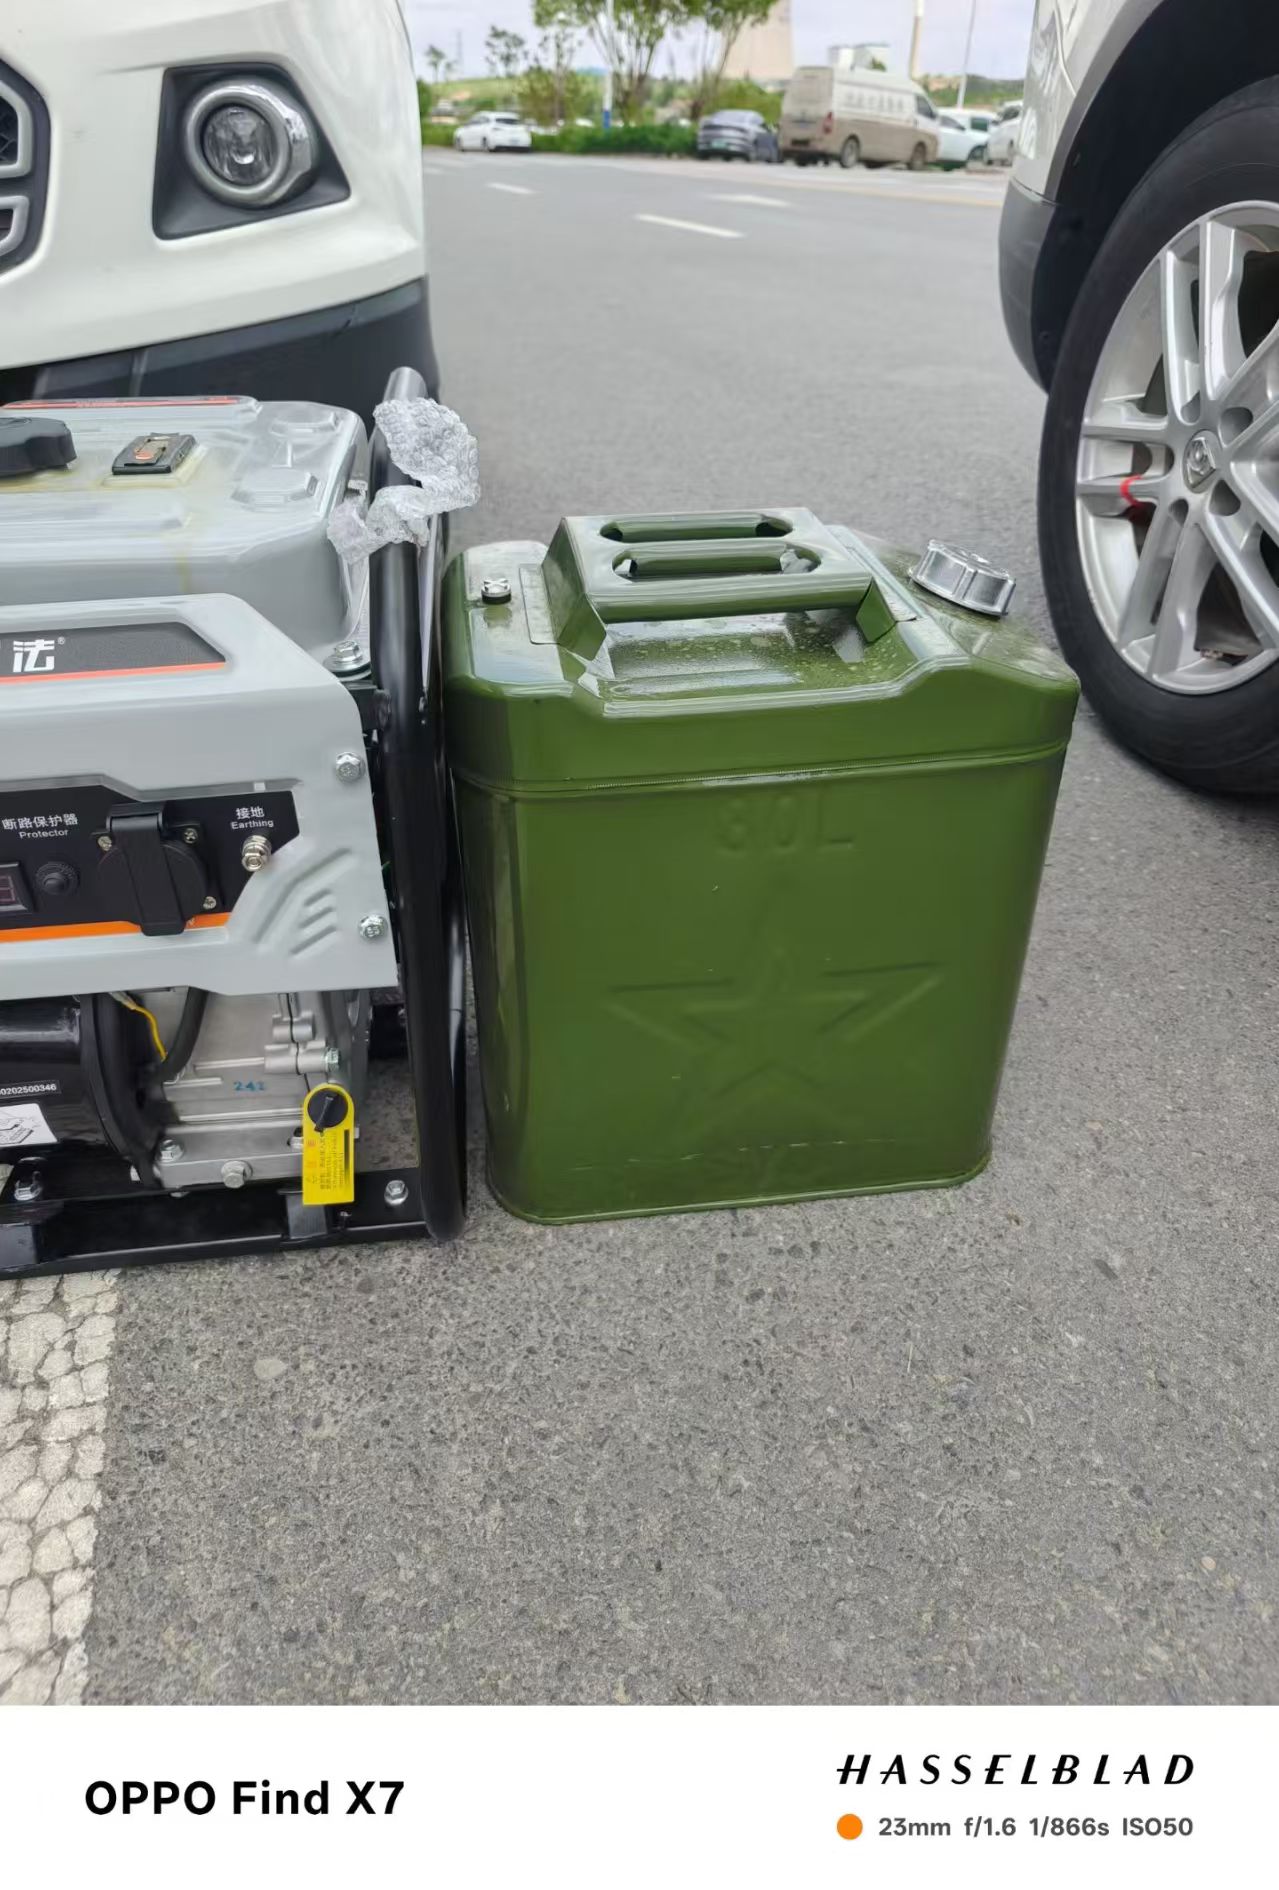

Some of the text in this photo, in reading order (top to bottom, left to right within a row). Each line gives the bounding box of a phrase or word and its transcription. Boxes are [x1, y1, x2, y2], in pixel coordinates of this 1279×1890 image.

[236, 806, 265, 819] 接地
[2, 813, 78, 830] 断路保护器
[231, 820, 274, 829] Earthing
[19, 829, 68, 839] Protector
[0, 1083, 57, 1096] 0202500346
